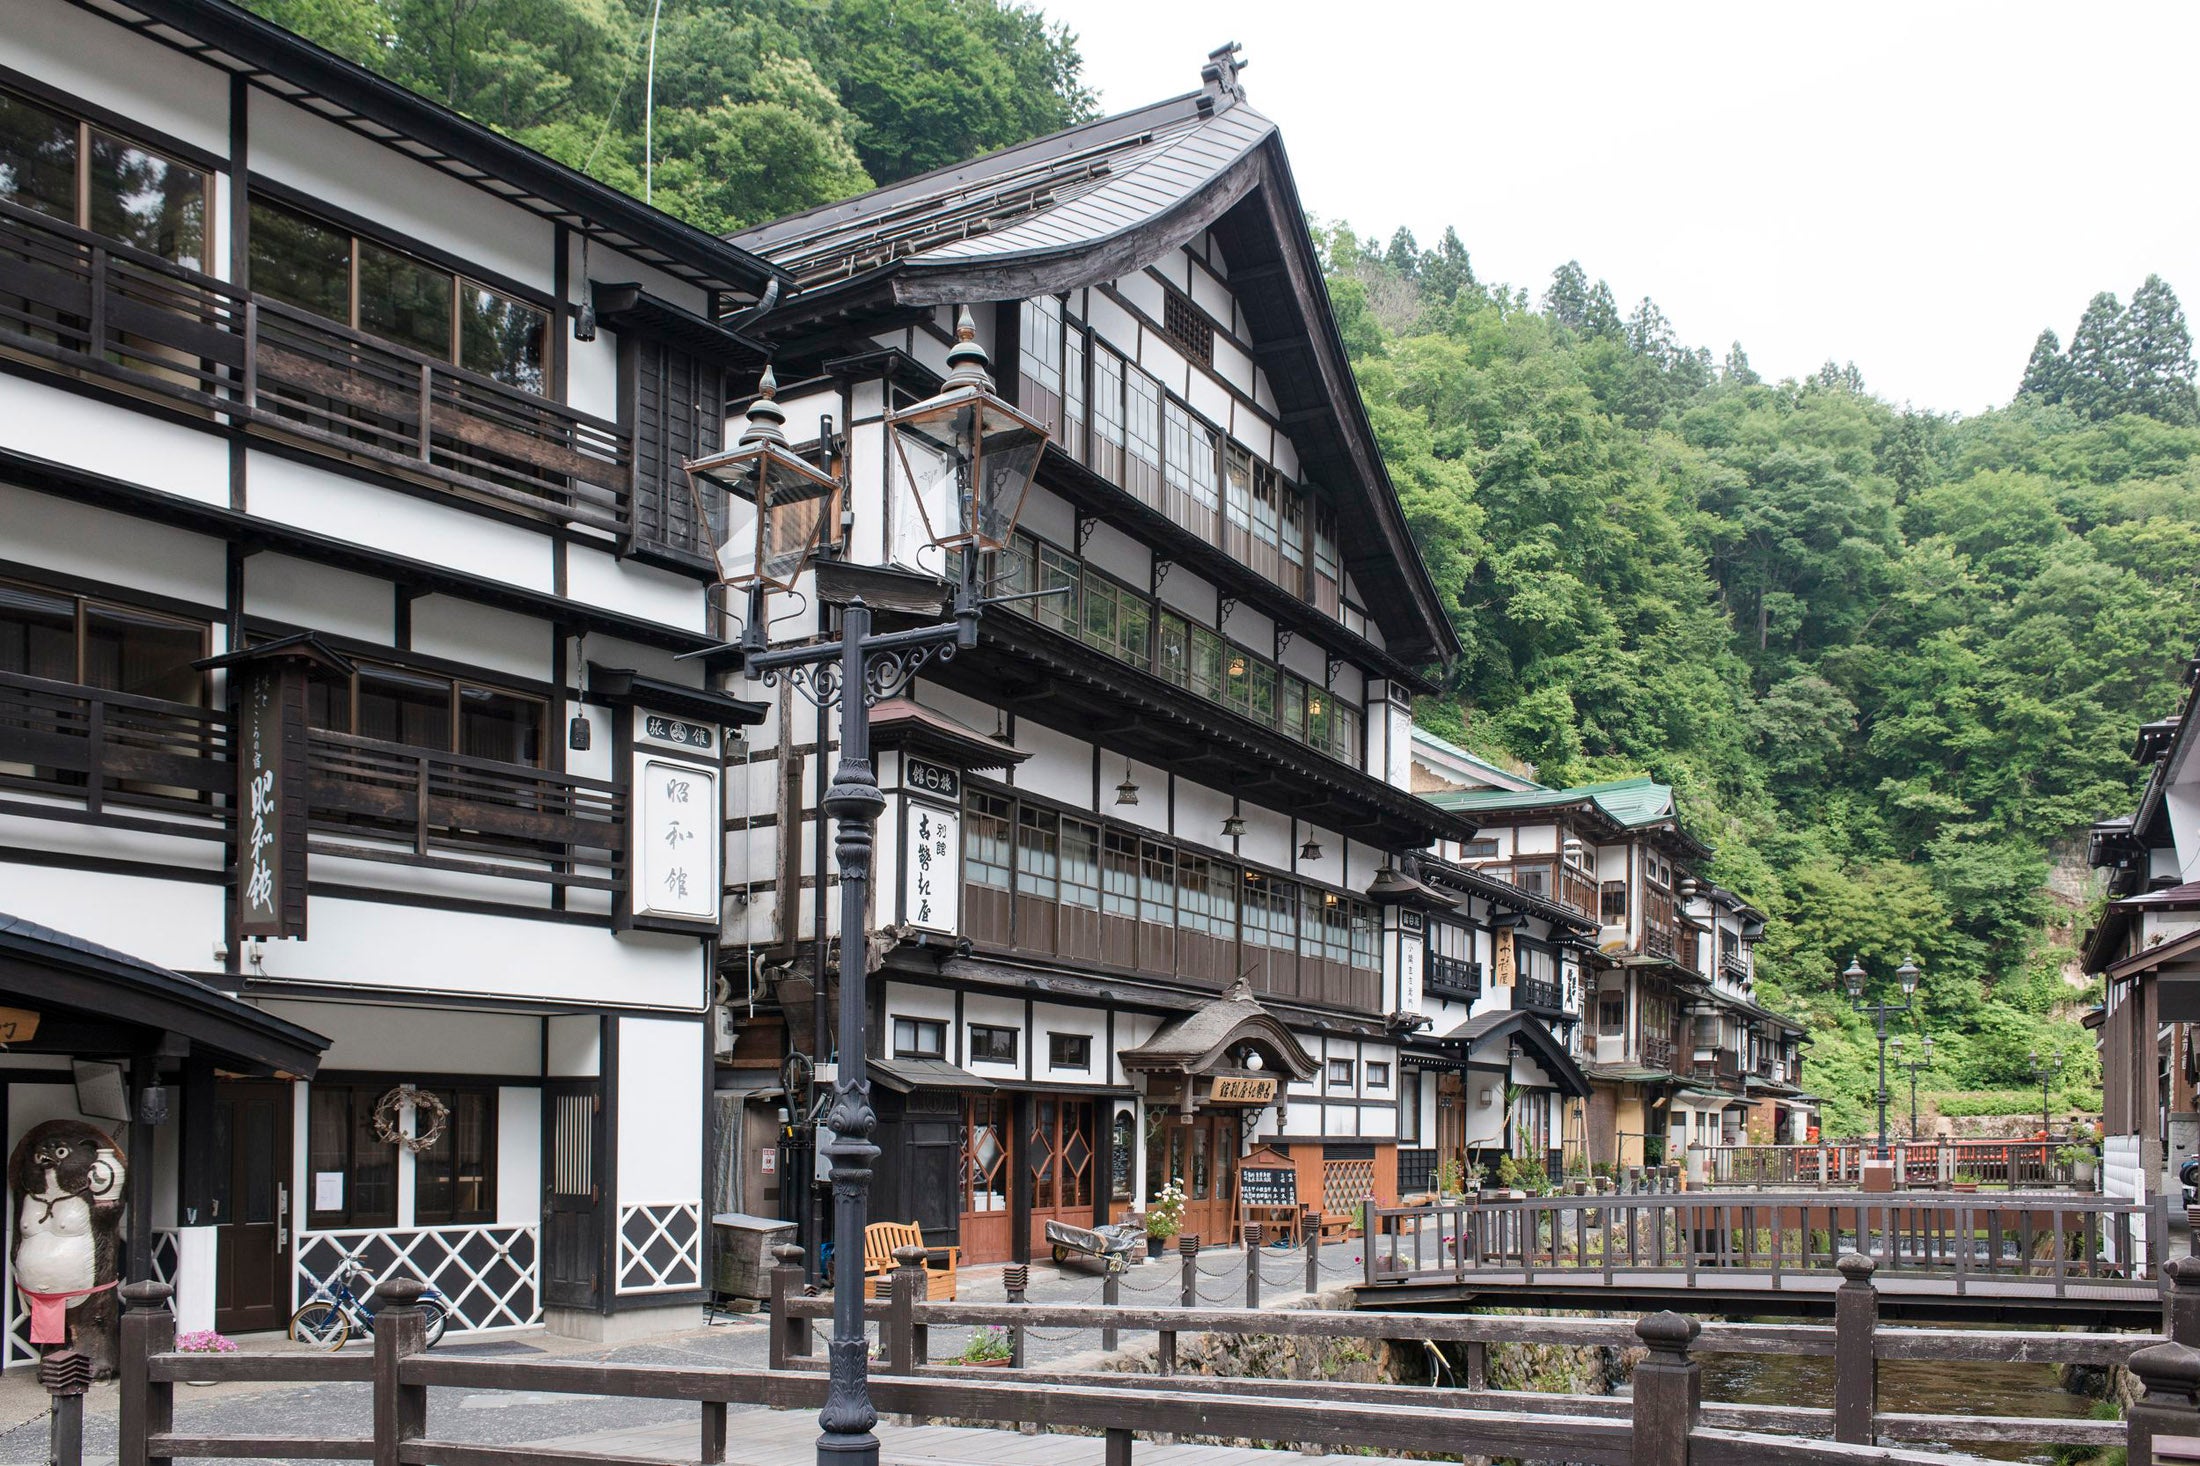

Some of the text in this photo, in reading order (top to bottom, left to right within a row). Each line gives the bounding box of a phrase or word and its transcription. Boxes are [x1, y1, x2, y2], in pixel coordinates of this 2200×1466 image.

[246, 769, 275, 915] 昭和館
[663, 778, 694, 900] 昭和館
[936, 823, 947, 857] 別館
